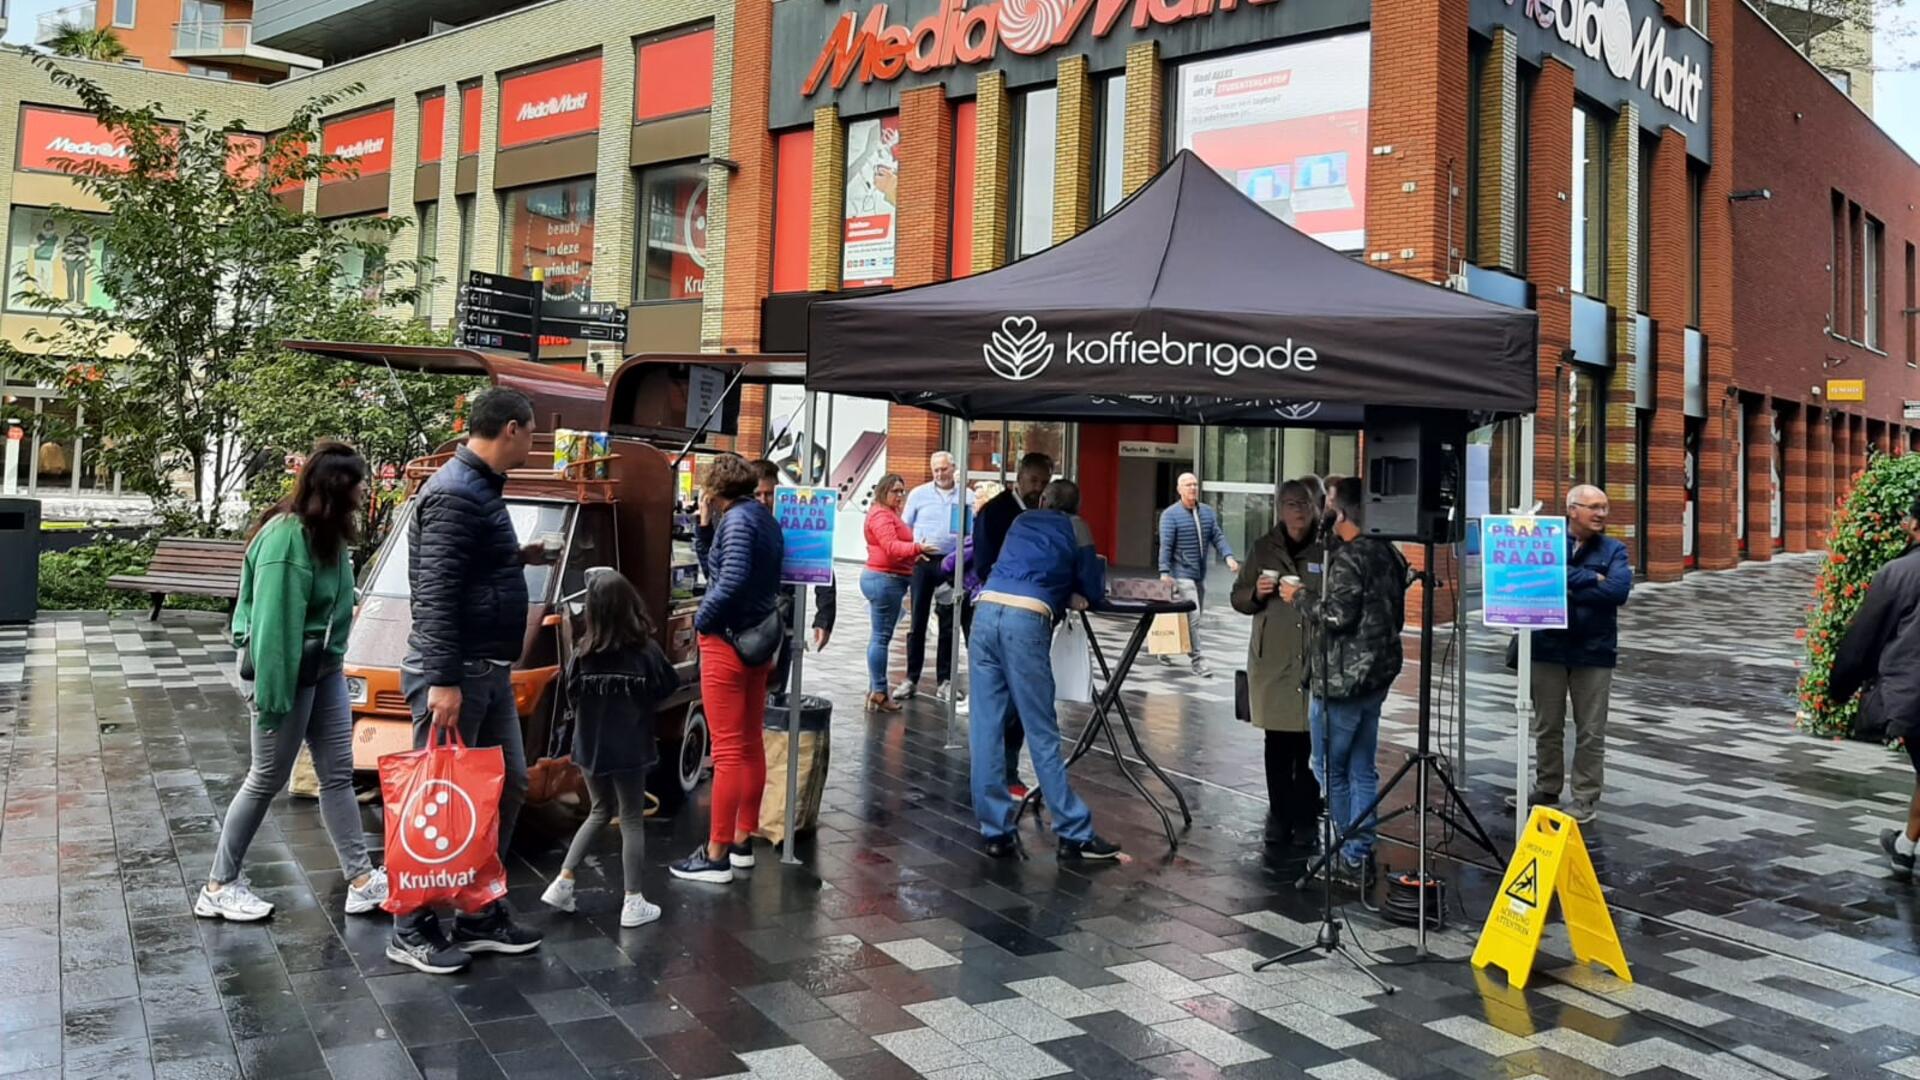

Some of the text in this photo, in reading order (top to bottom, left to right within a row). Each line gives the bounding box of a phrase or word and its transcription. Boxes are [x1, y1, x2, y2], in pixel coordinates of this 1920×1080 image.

[547, 221, 581, 236] beauty
[546, 242, 580, 256] in deze
[1066, 331, 1318, 376] koffiebrigade
[781, 494, 829, 505] PRAAT
[780, 517, 827, 531] RAAD
[1491, 525, 1556, 538] PRAAT
[1492, 550, 1556, 565] RAAD
[398, 867, 477, 890] Kruidvat
